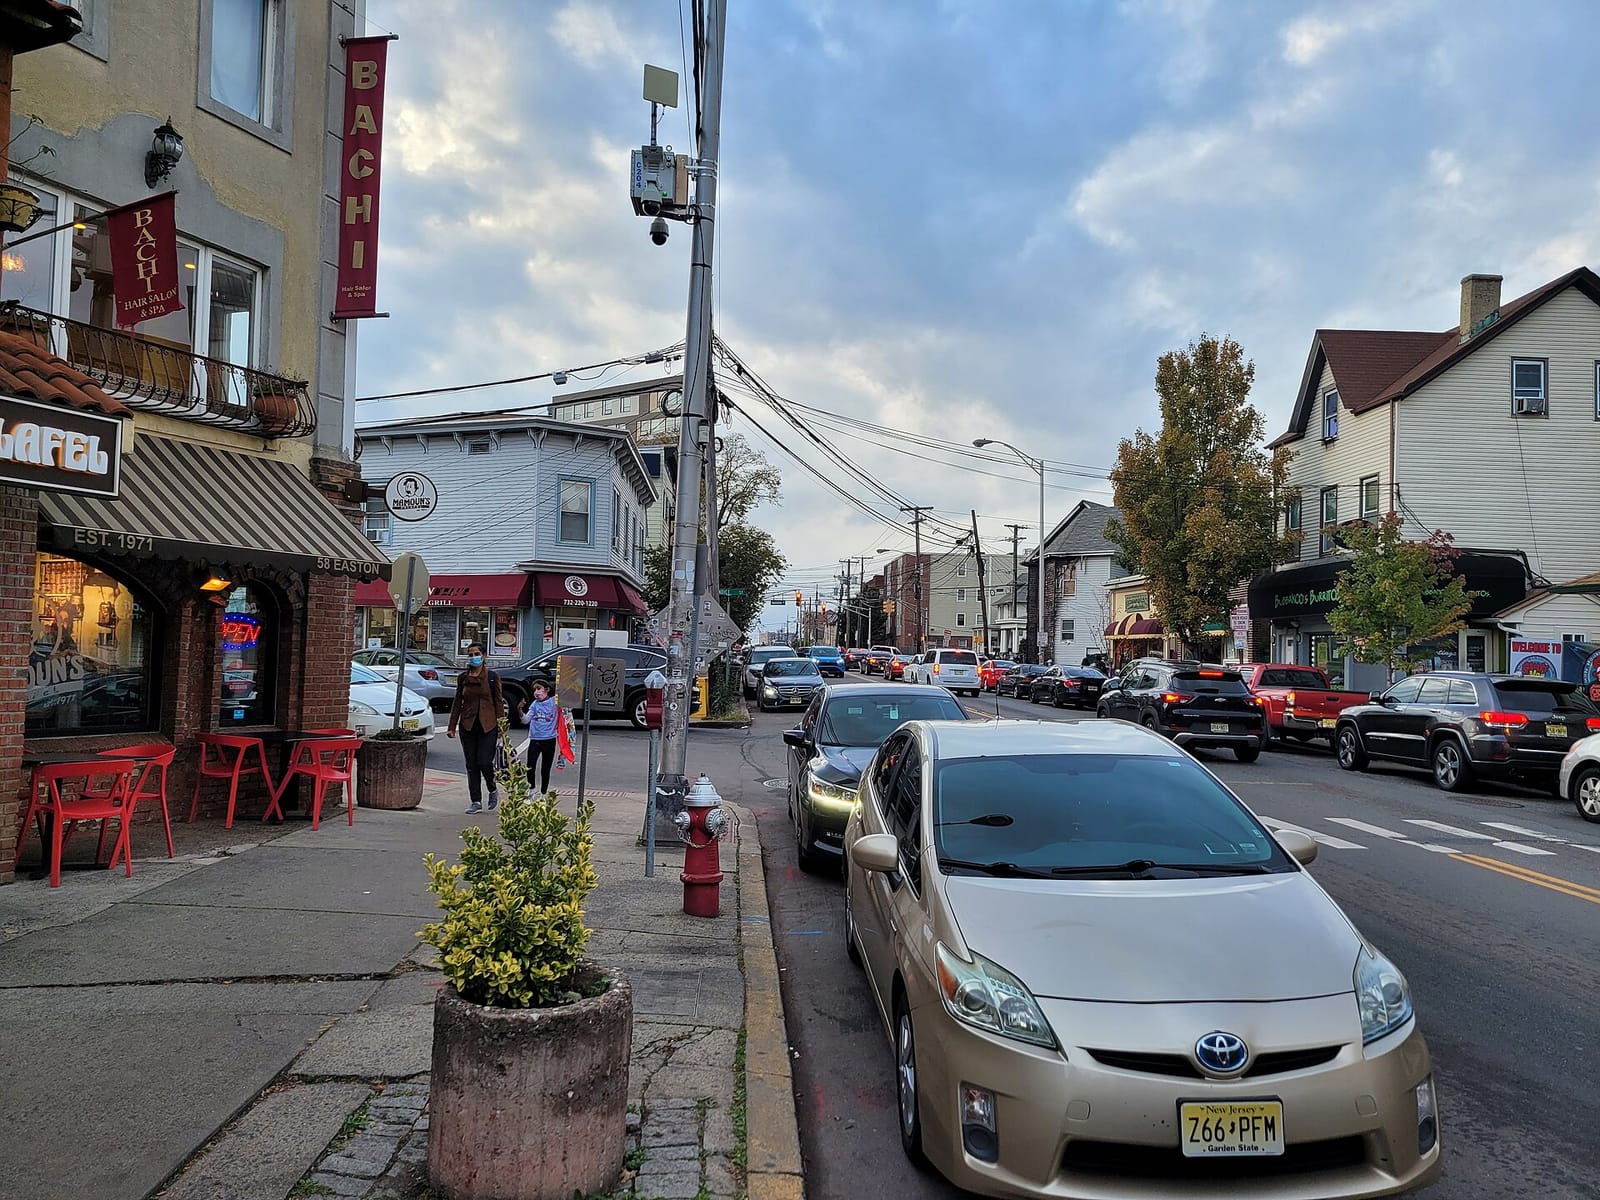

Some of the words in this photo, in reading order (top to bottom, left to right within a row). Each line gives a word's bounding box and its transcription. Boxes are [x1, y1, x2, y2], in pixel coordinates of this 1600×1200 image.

[345, 60, 378, 270] BACHI
[133, 209, 159, 293] BACHI
[125, 297, 147, 310] HAIR
[148, 287, 177, 304] SALON
[140, 308, 148, 318] &
[148, 304, 165, 315] SPA
[392, 497, 431, 507] MAMOUN'S
[74, 528, 111, 546] EST.
[118, 533, 153, 551] 1971
[317, 557, 330, 569] 58
[334, 560, 380, 575] EASTON
[222, 622, 261, 642] PEN
[1512, 641, 1550, 653] WELCOME
[1551, 643, 1562, 654] TO
[1206, 1105, 1226, 1114] New
[1229, 1105, 1257, 1115] Jersey
[1238, 1144, 1258, 1152] State
